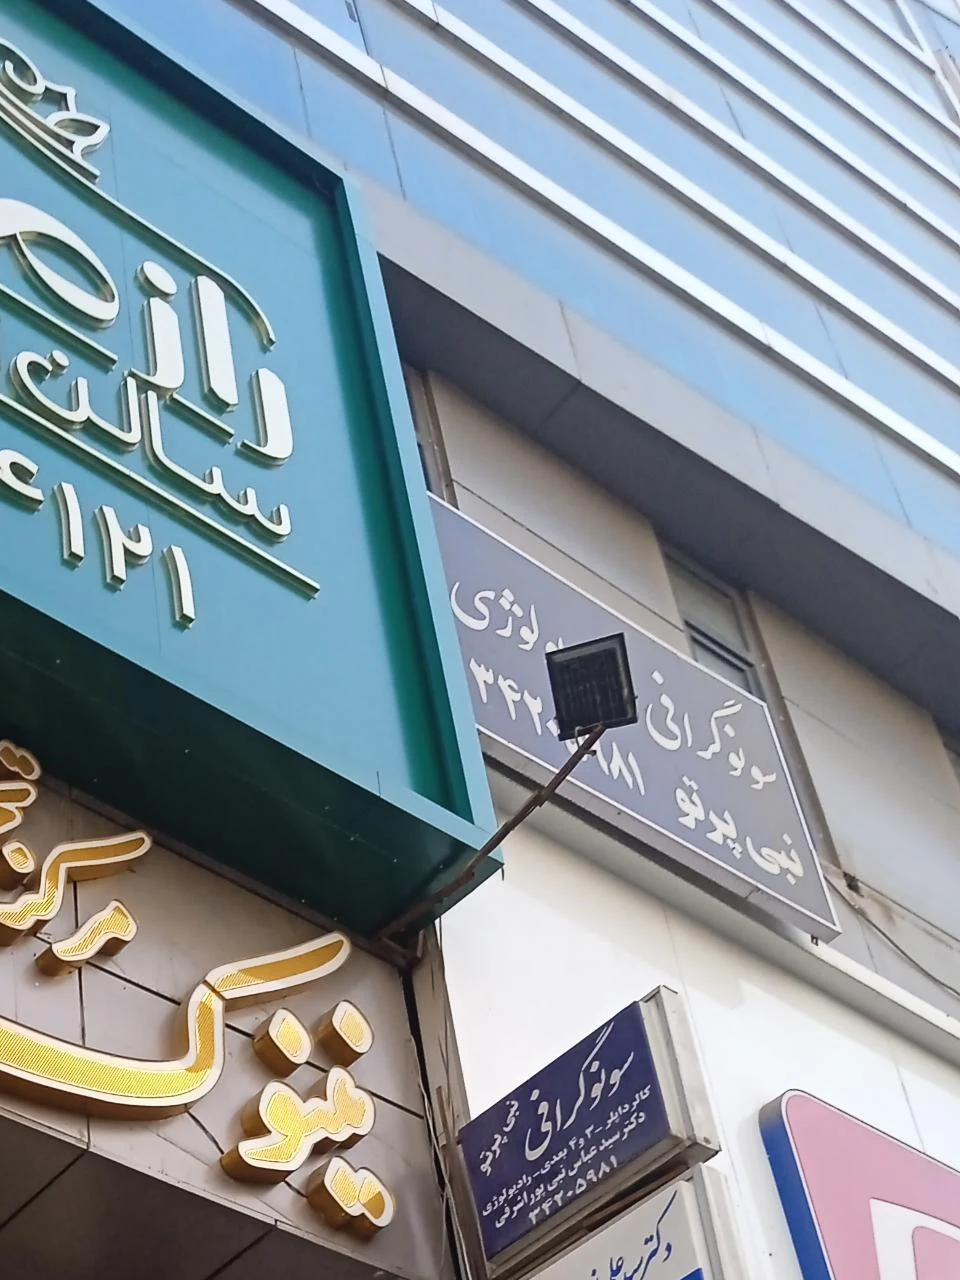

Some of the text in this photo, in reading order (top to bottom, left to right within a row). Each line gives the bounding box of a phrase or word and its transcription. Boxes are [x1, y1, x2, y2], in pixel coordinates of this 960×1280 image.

[10, 350, 290, 540] سالن
[675, 776, 743, 860] پرتو
[746, 832, 804, 886] نبی
[525, 1021, 635, 1161] سونوگرافی
[599, 1130, 620, 1151] سید
[622, 1111, 645, 1141] دکتر
[547, 1164, 566, 1192] نبی
[568, 1145, 598, 1177] عباس
[528, 1155, 618, 1225] ۳۴۲۰۵۹۸۱
